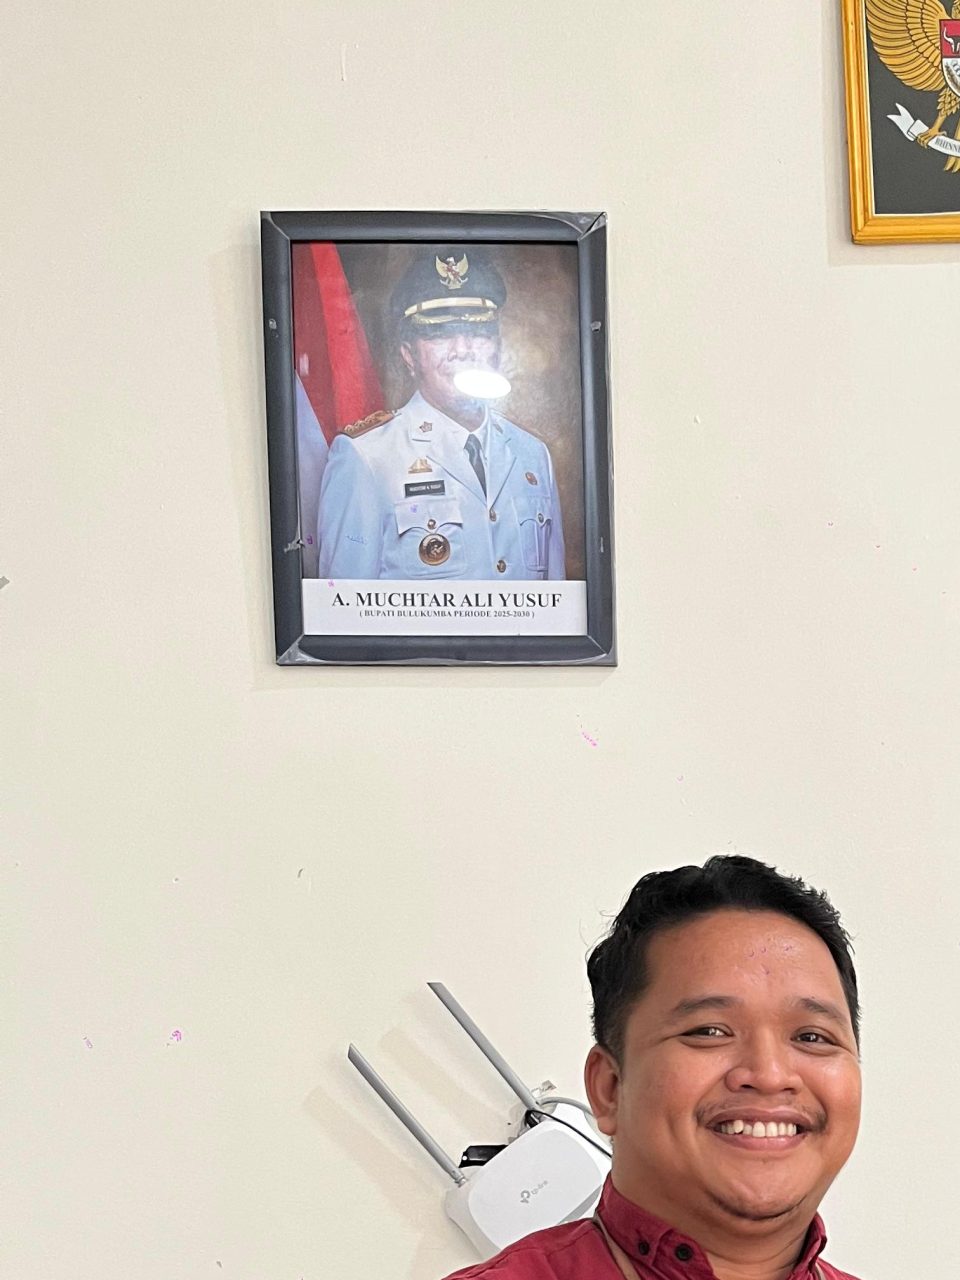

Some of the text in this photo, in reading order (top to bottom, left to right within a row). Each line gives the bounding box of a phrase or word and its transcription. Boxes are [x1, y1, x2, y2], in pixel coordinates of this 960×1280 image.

[332, 592, 562, 607] A. MUCHTAR ALI YUSUF
